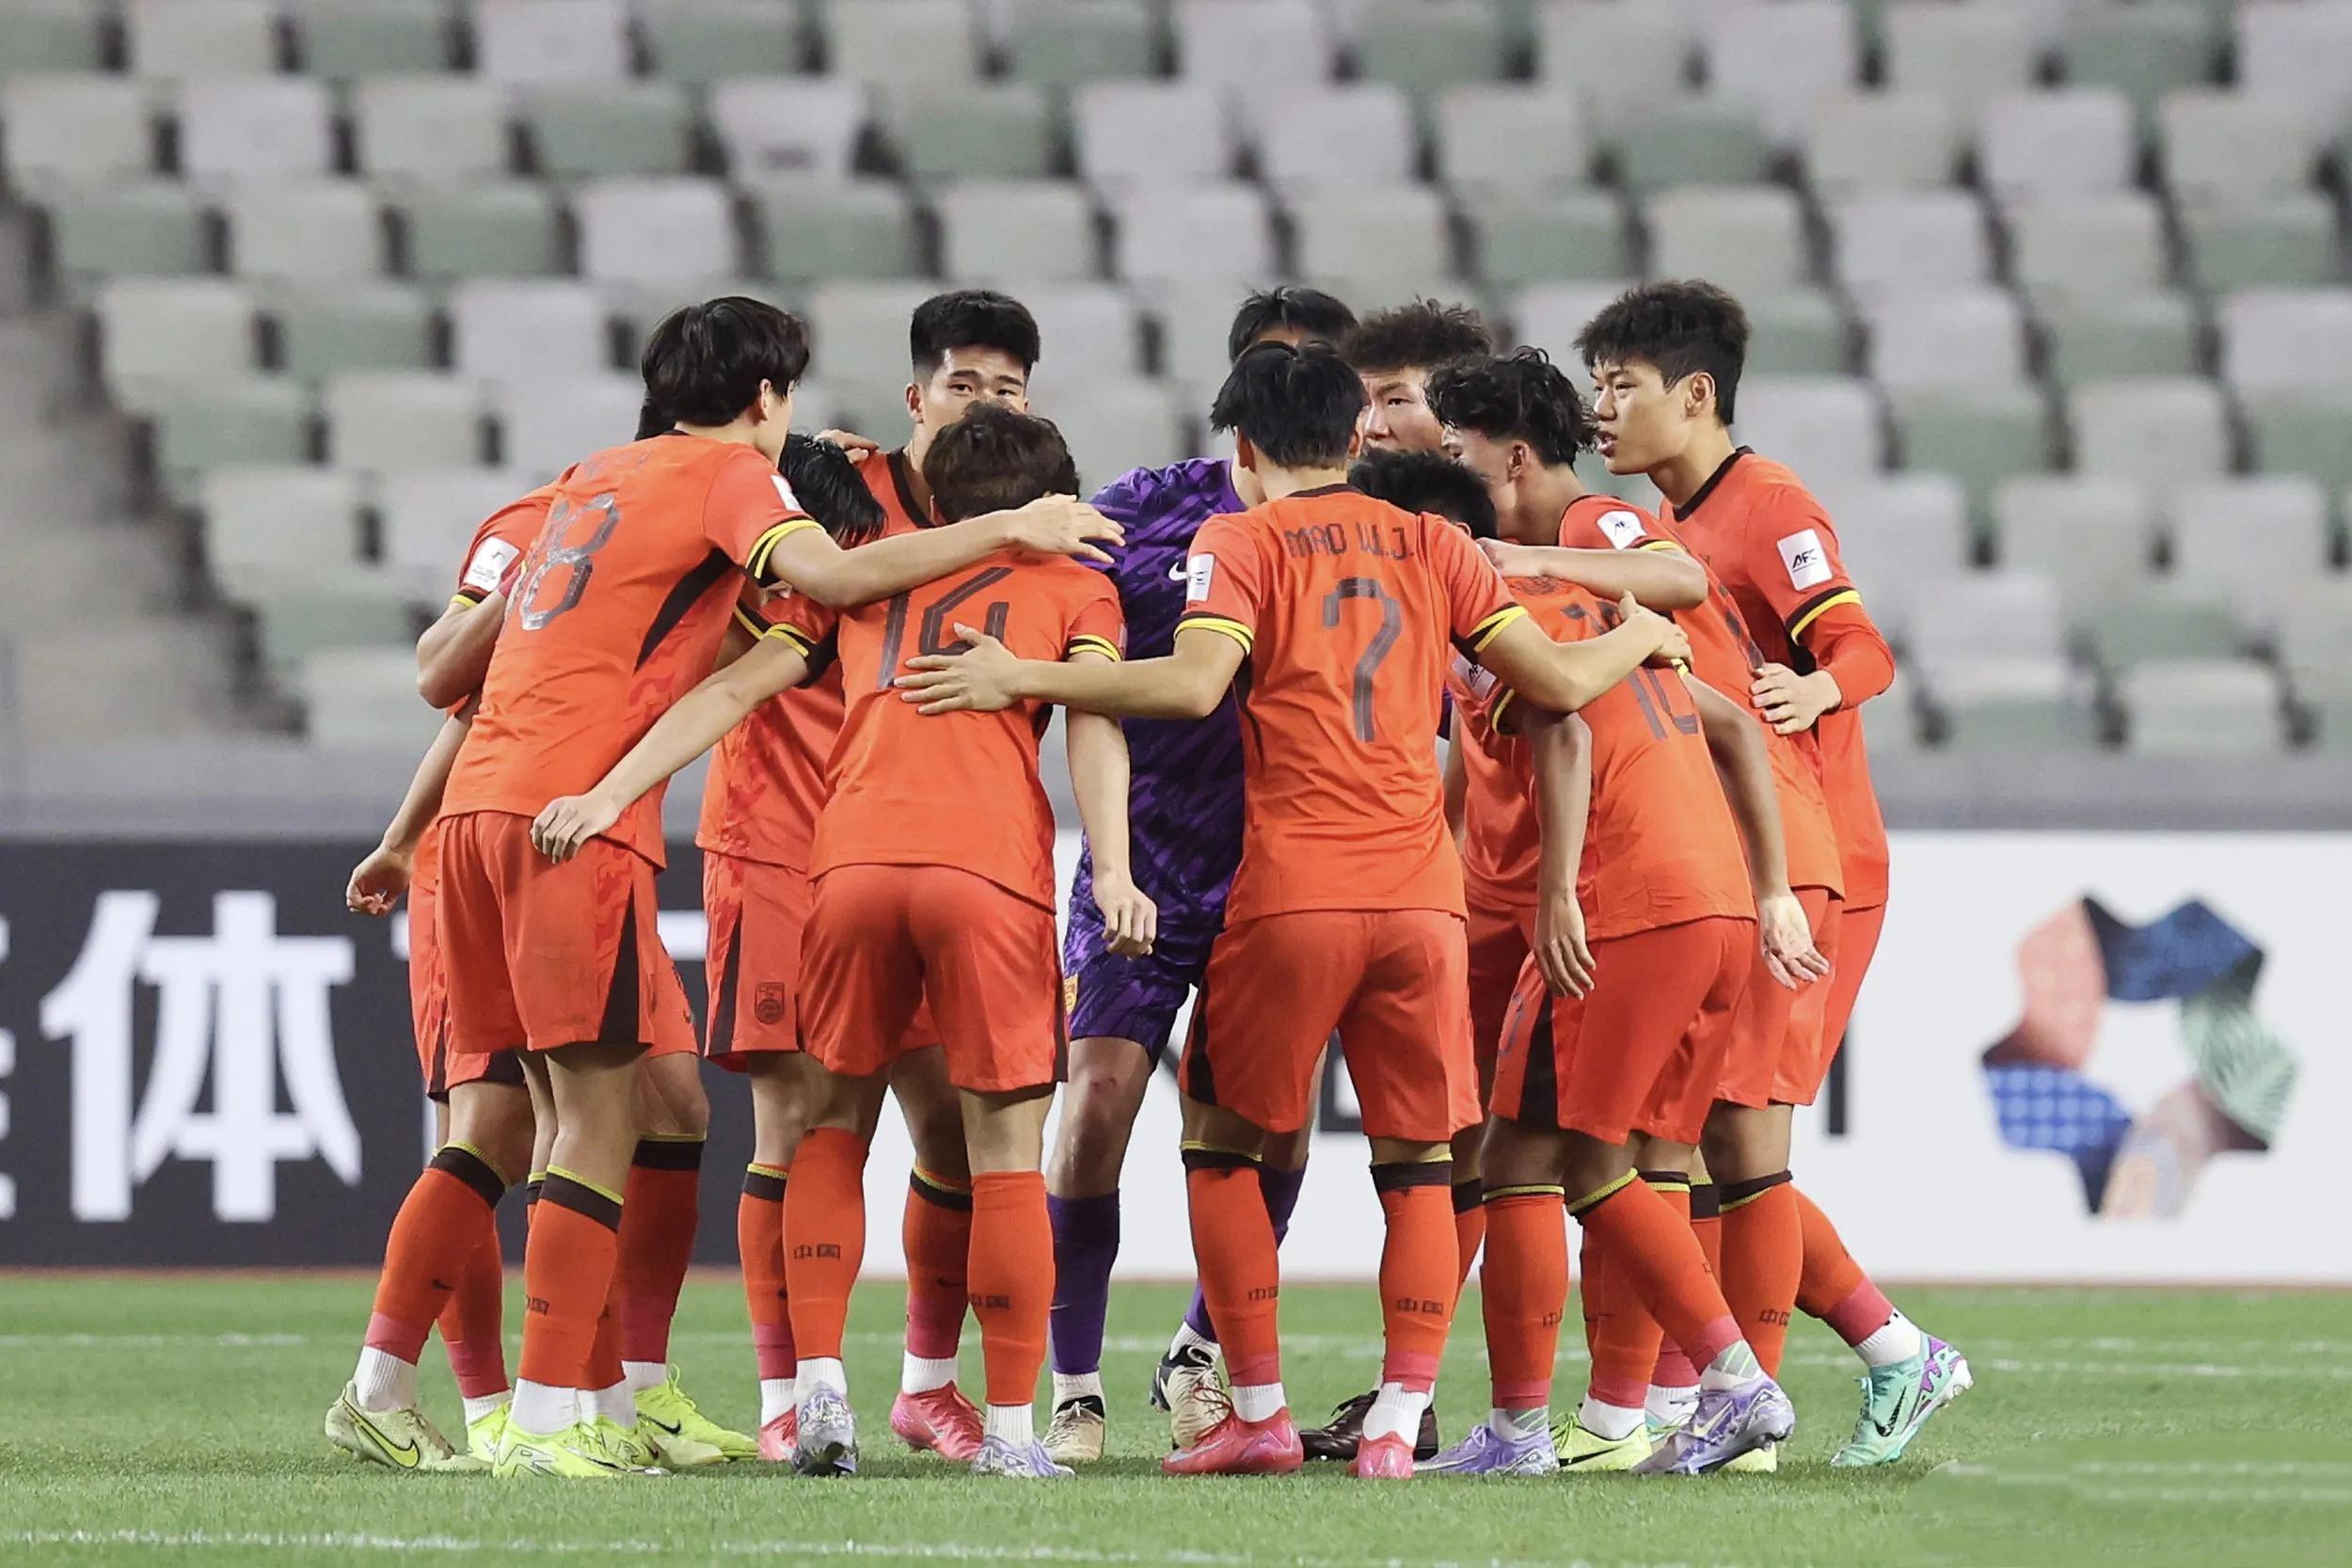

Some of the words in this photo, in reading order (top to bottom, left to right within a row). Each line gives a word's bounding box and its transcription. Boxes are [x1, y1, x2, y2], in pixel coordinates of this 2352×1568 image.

[1284, 523, 1347, 558] MAO
[1322, 577, 1402, 743] 7
[40, 889, 361, 1222] 体
[793, 1243, 841, 1260] 中国
[1396, 1298, 1444, 1316] 中国
